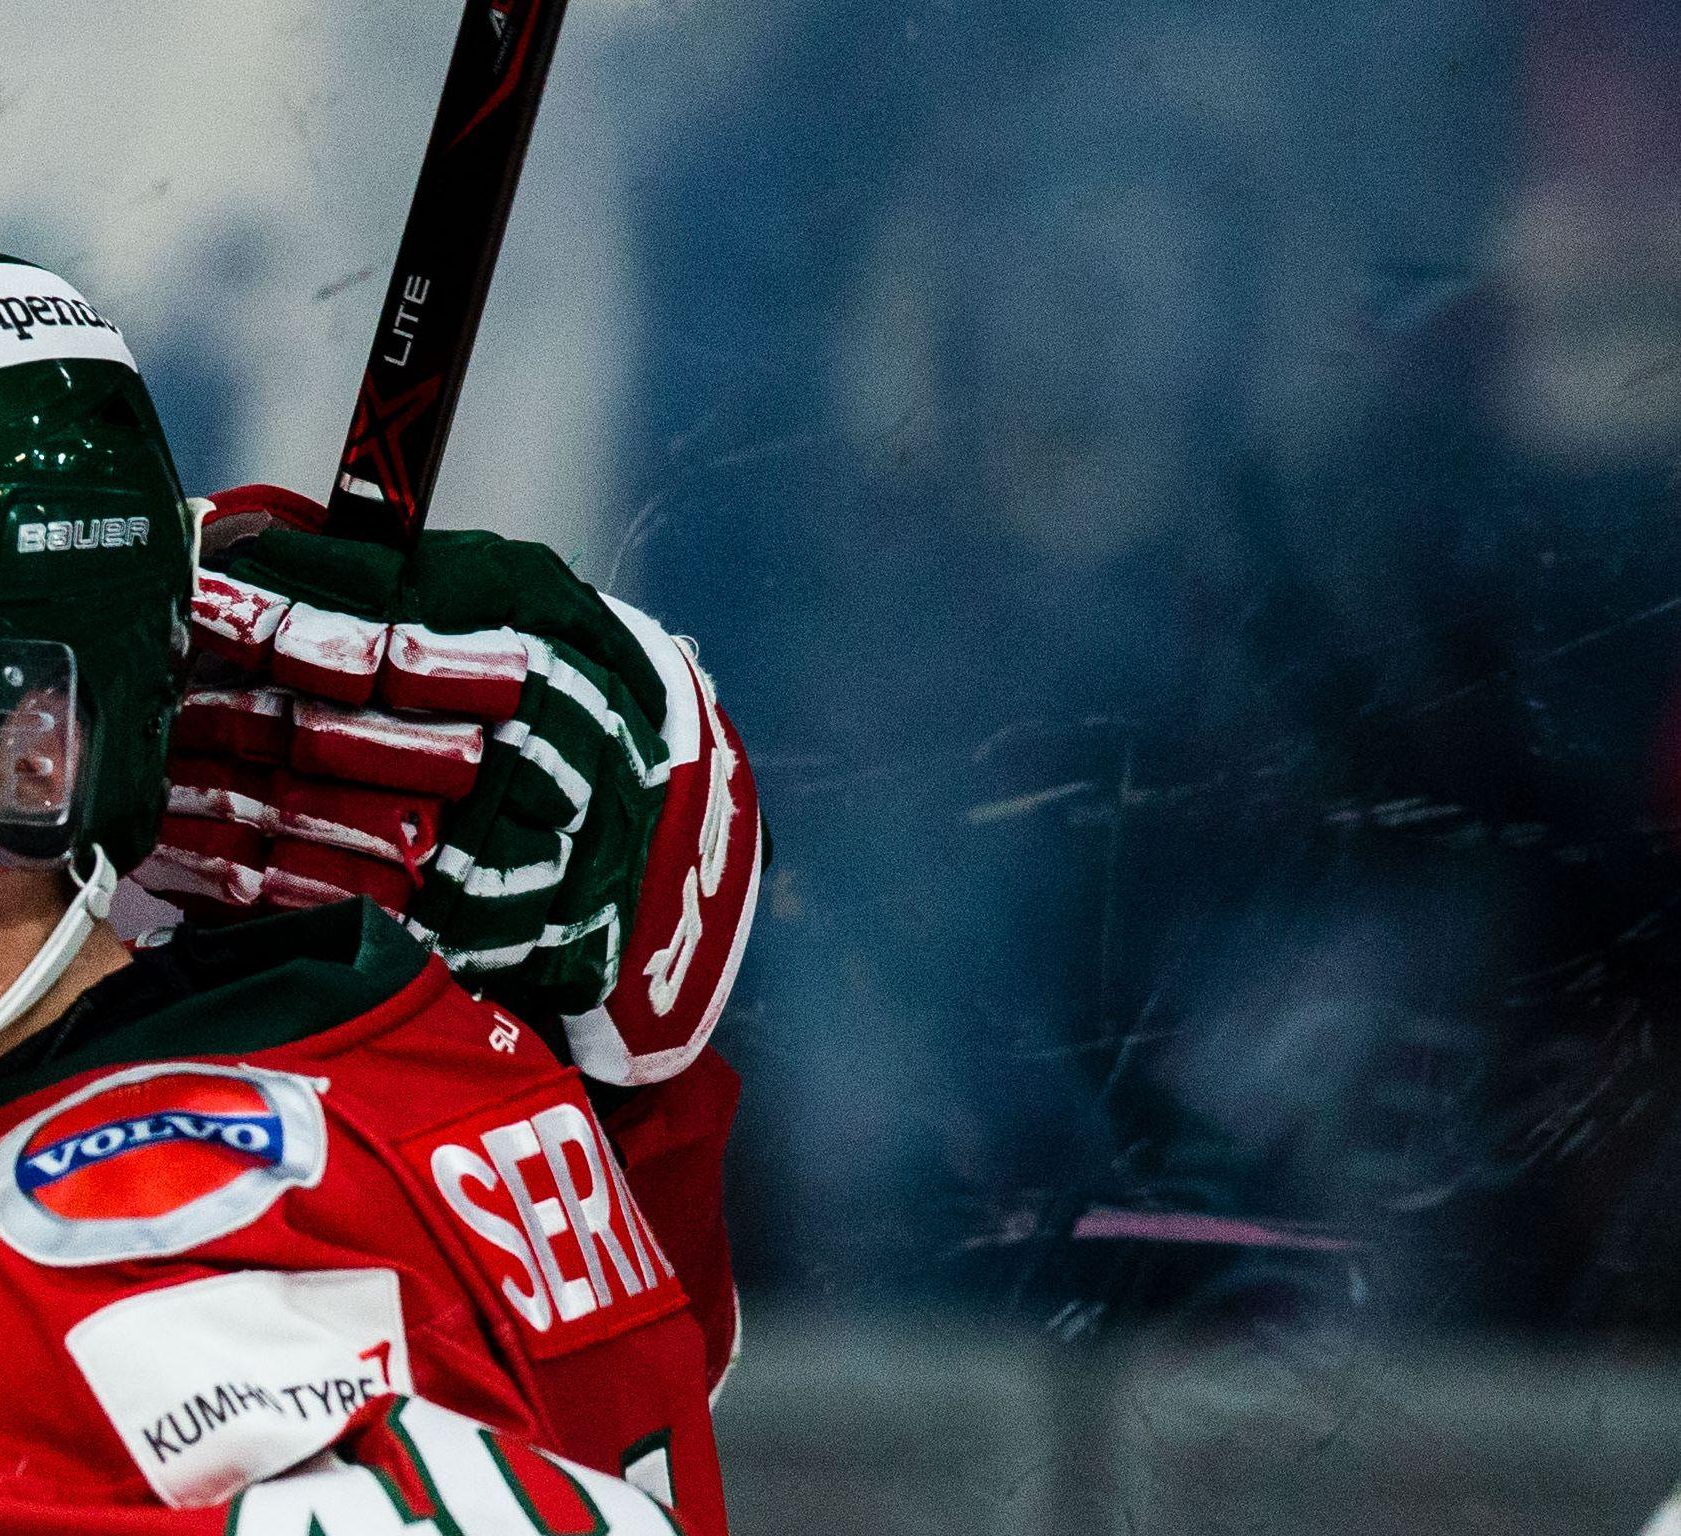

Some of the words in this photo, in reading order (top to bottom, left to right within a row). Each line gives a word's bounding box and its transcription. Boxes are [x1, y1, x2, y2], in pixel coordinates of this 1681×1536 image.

[383, 275, 431, 368] LITE
[17, 516, 151, 553] BAUER
[24, 1112, 271, 1182] VOLVO
